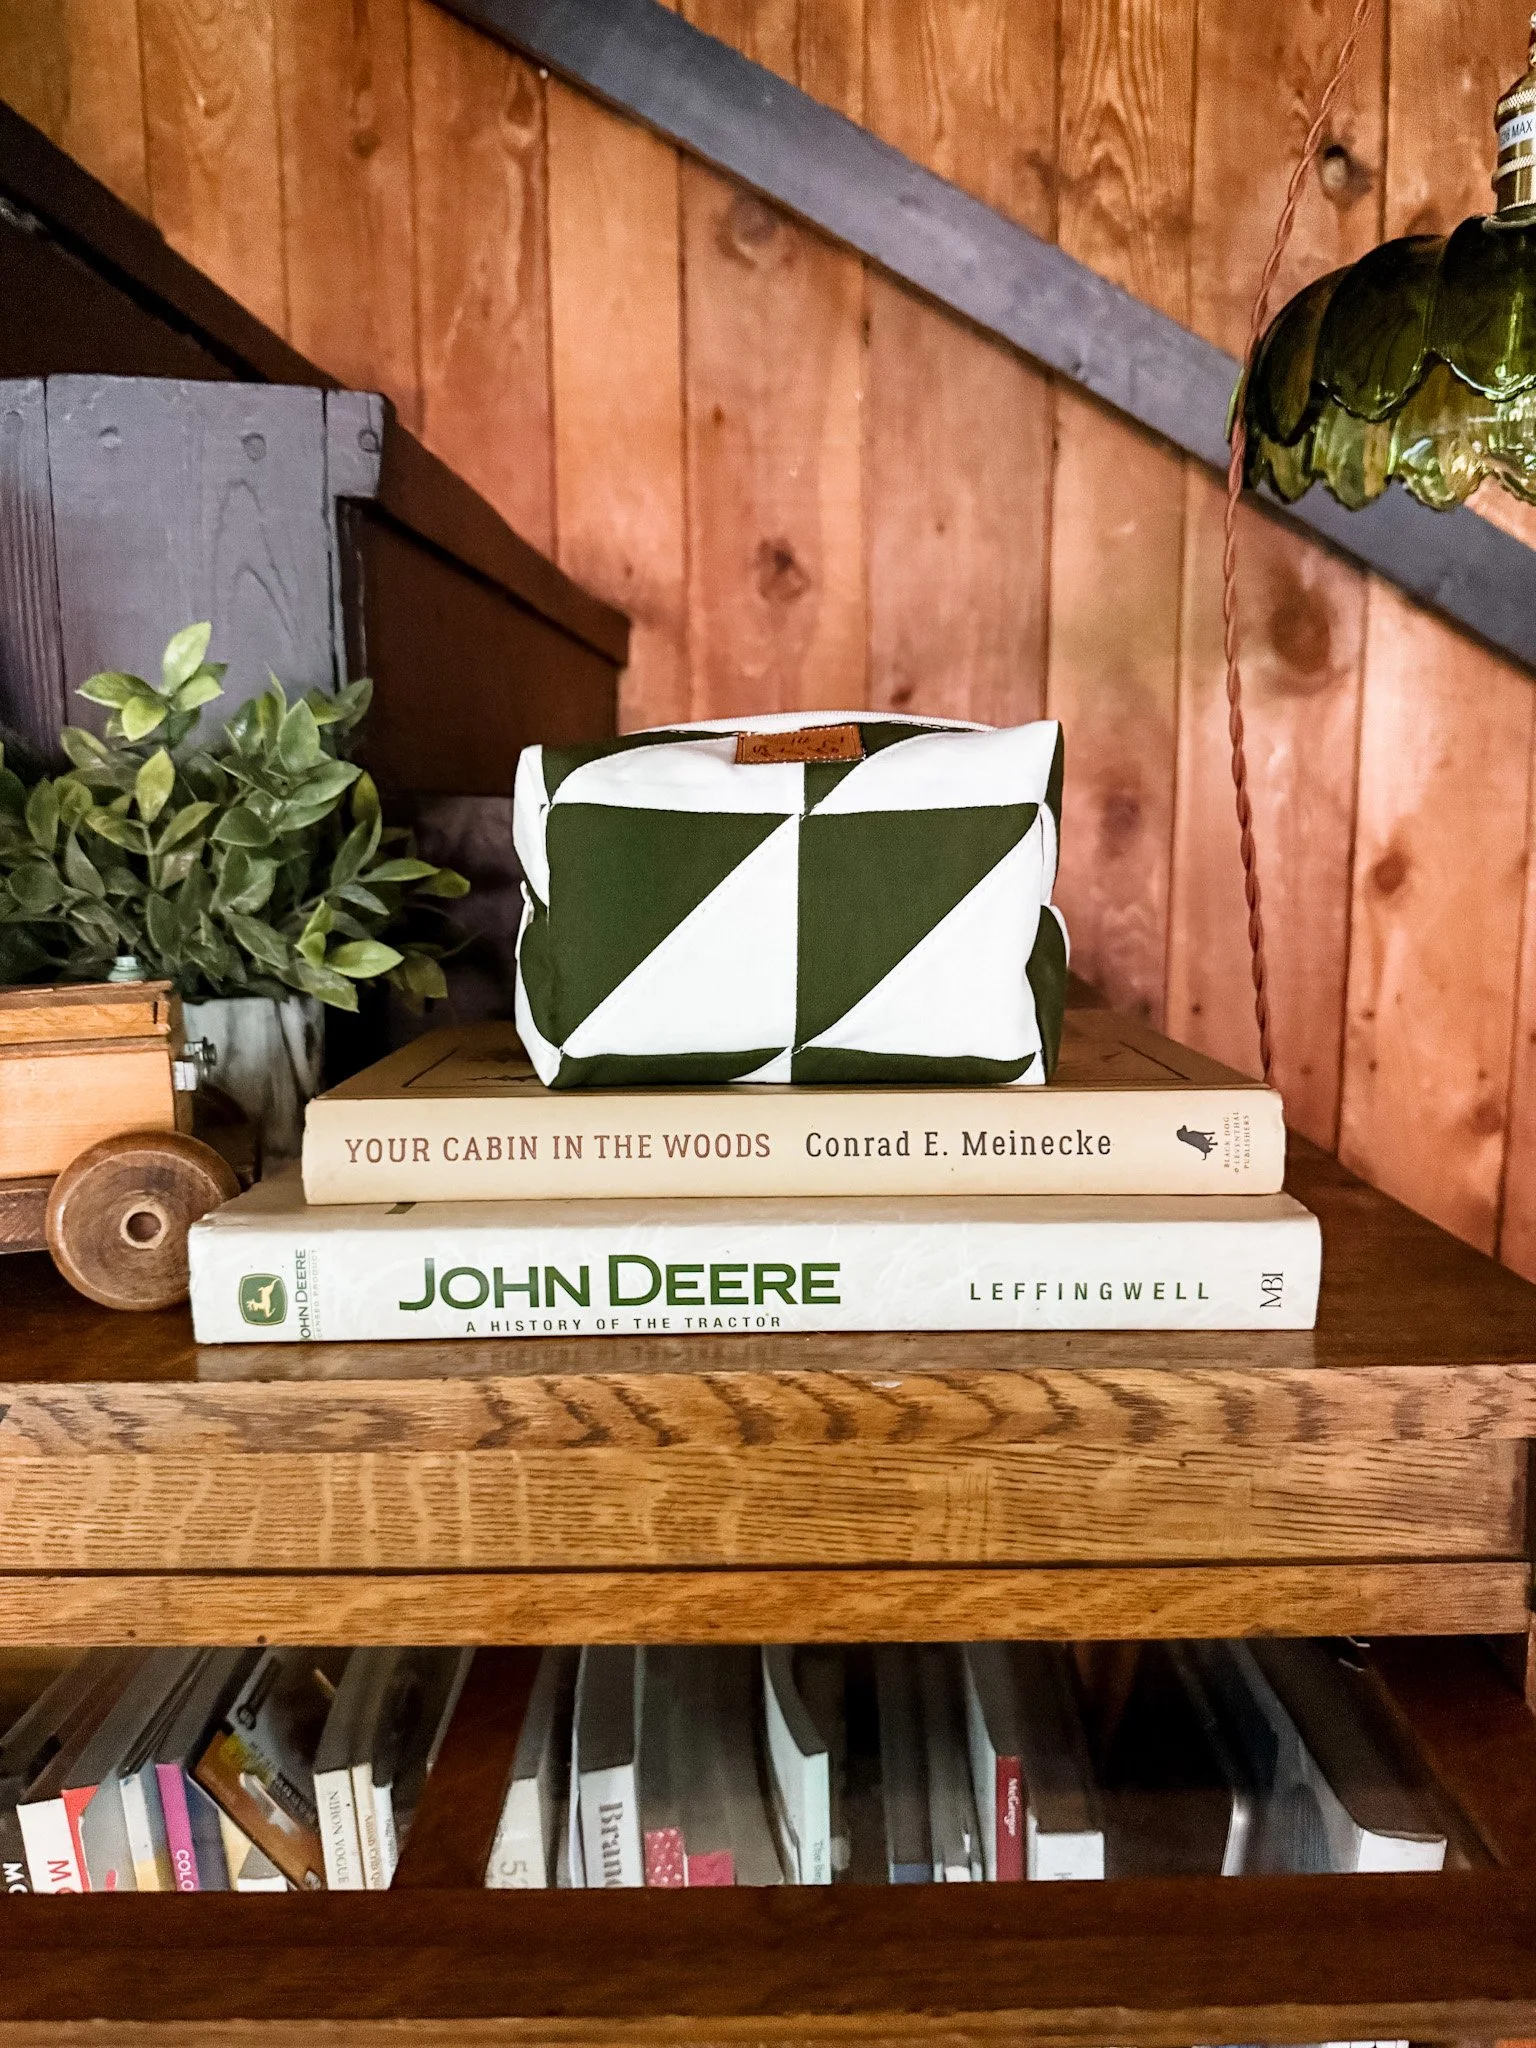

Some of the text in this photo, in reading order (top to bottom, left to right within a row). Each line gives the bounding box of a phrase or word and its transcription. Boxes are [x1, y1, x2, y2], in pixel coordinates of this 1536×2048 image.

[1512, 119, 1533, 138] MAX
[1223, 1116, 1231, 1136] DOG
[345, 1133, 771, 1163] YOUR CABIN IN THE WOODS
[805, 1129, 1111, 1158] Conrad E. Meinecke
[295, 1249, 312, 1341] OHN DEERE
[399, 1254, 841, 1312] JOHN DEERE
[970, 1282, 1210, 1301] LEFFINGWELL
[465, 1315, 781, 1333] A HISTORY OF THE TRACTOR
